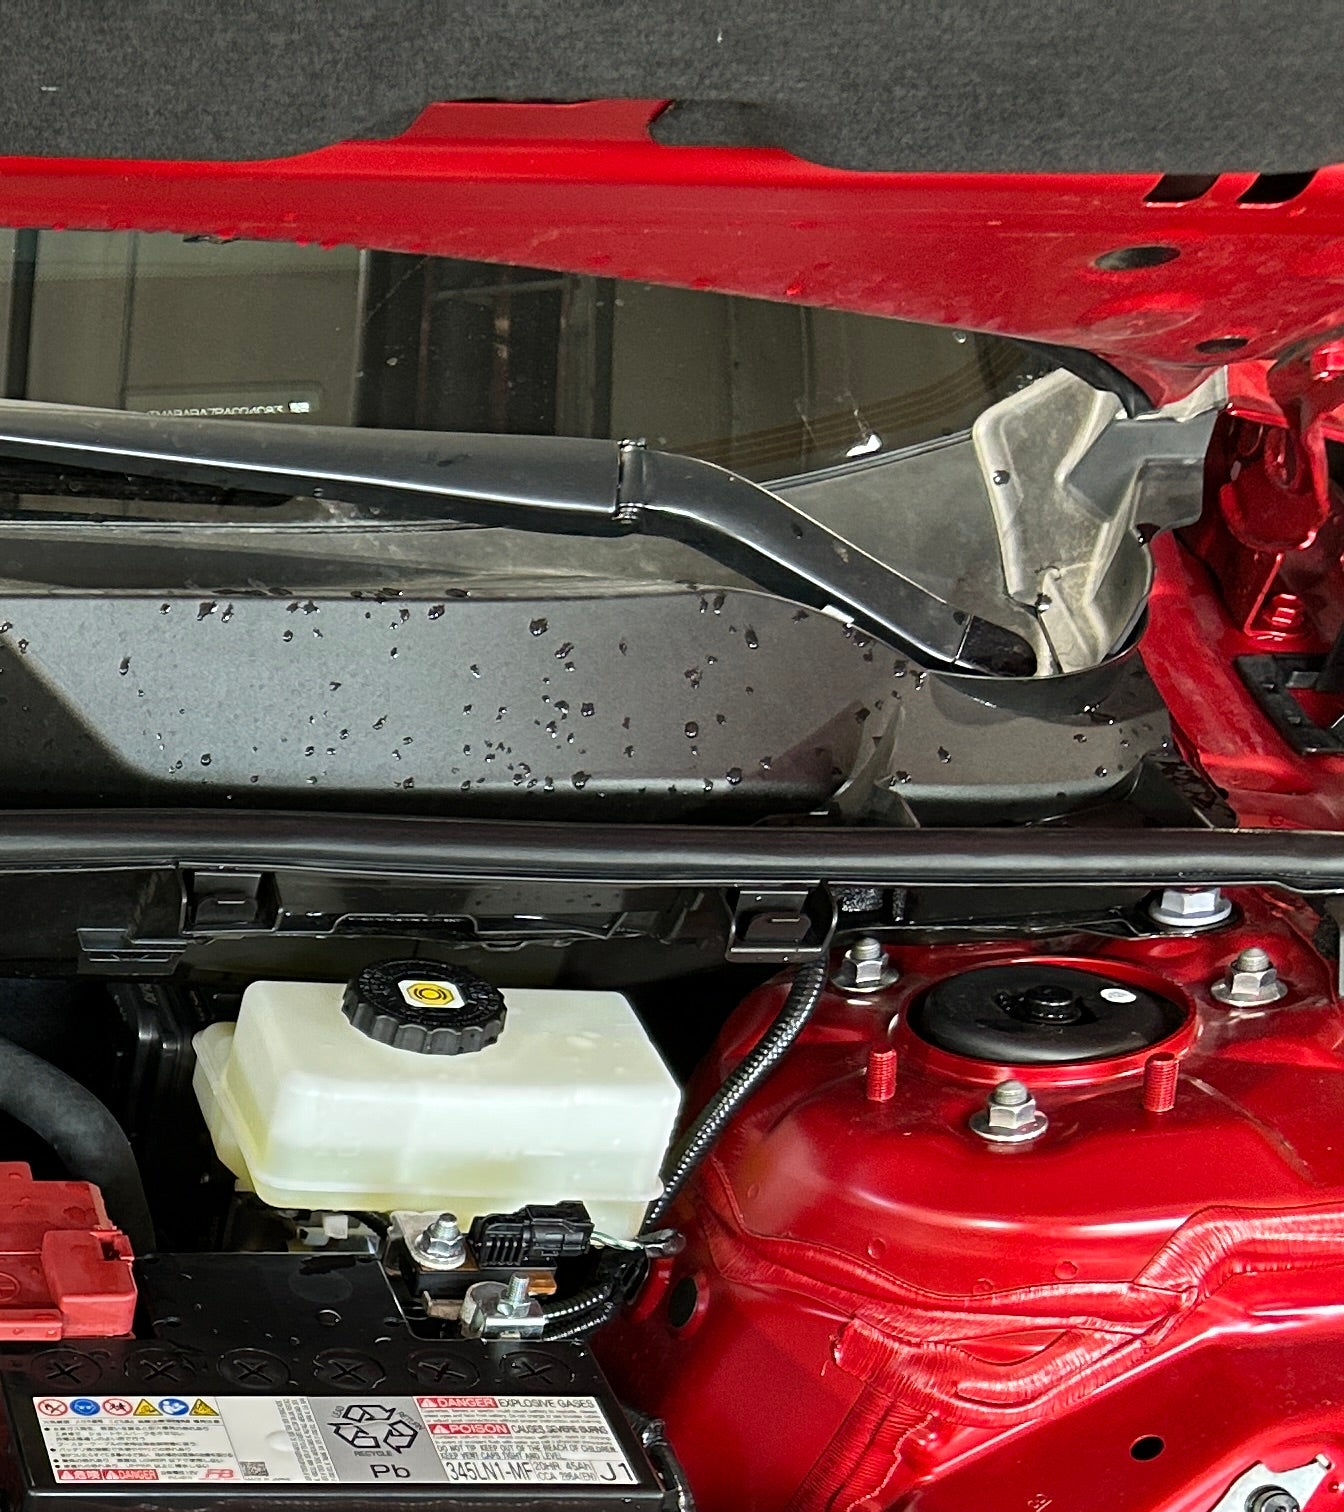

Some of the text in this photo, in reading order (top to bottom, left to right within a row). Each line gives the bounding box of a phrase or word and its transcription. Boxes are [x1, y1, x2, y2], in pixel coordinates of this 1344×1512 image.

[438, 1398, 595, 1408] DANGER EXPLOSIVE GASES
[449, 1424, 508, 1433] POISON
[118, 1470, 157, 1480] DANGER
[370, 1464, 411, 1478] Pb
[446, 1462, 532, 1480] 345LN1-MF
